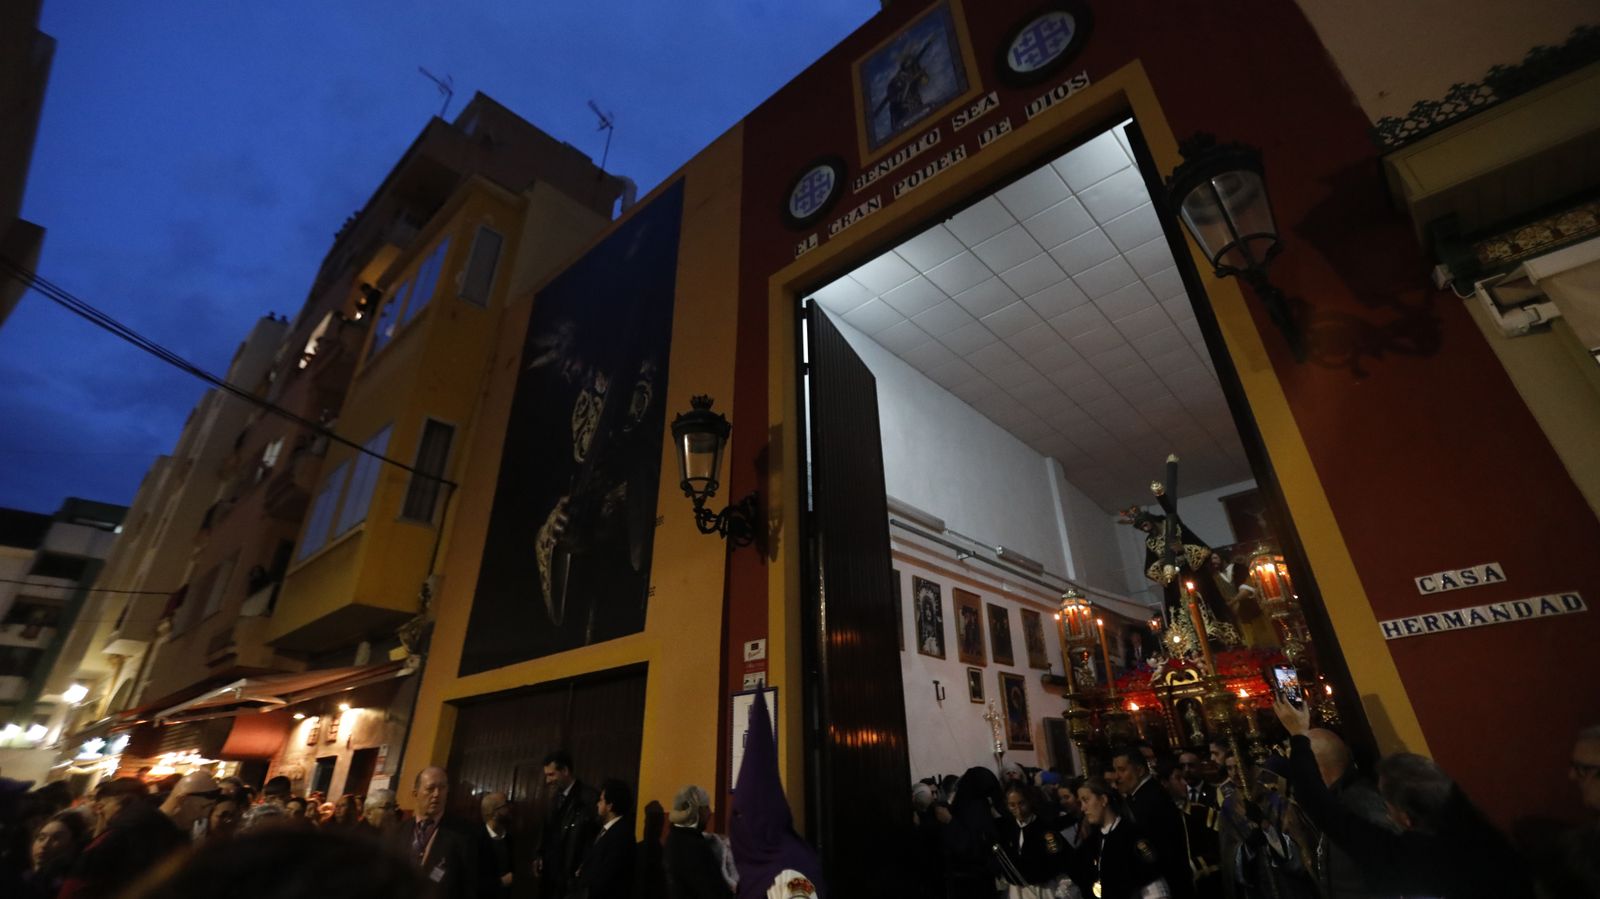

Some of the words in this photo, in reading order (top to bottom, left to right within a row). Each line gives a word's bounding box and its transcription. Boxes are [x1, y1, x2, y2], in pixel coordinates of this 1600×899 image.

[795, 234, 818, 258] EL
[828, 197, 880, 237] GRAN
[894, 147, 966, 198] PODER
[978, 119, 1011, 146] DE
[1026, 73, 1089, 119] DIOS
[853, 130, 939, 191] BENDITO
[953, 95, 998, 129] SEA
[1418, 564, 1503, 593] CASA
[1381, 594, 1583, 639] HERMANDAD
